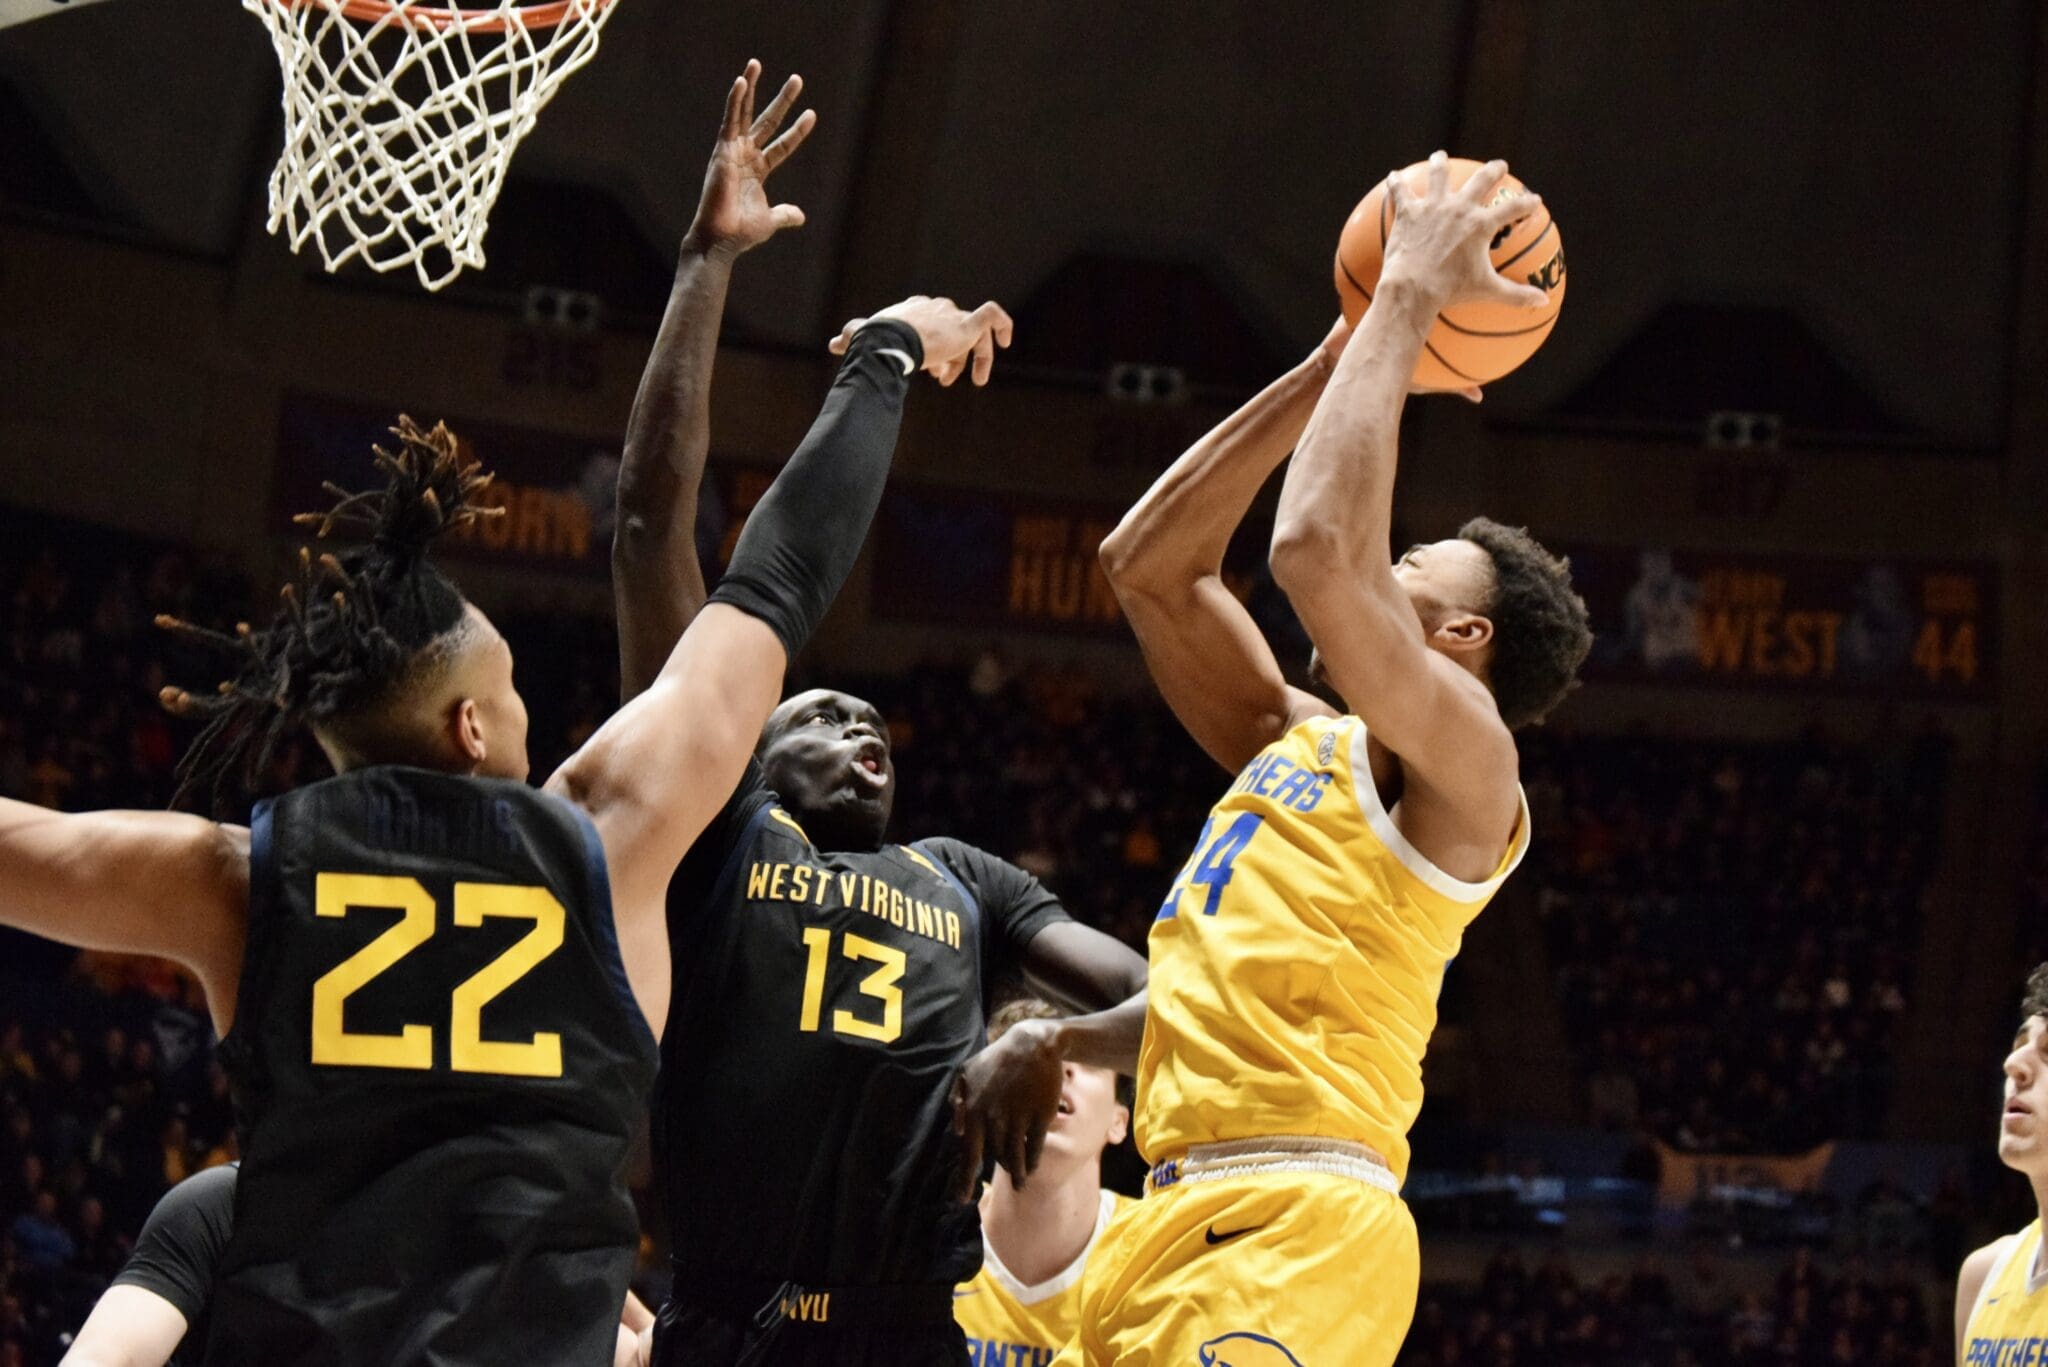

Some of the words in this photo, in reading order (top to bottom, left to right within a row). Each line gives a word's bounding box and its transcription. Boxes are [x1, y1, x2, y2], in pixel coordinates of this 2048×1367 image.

[1698, 607, 1841, 679] WEST
[1911, 616, 1978, 683] 44
[746, 862, 834, 906] WEST
[839, 870, 961, 951] VIRGINIA
[311, 870, 567, 1078] 22
[799, 926, 907, 1045] 13
